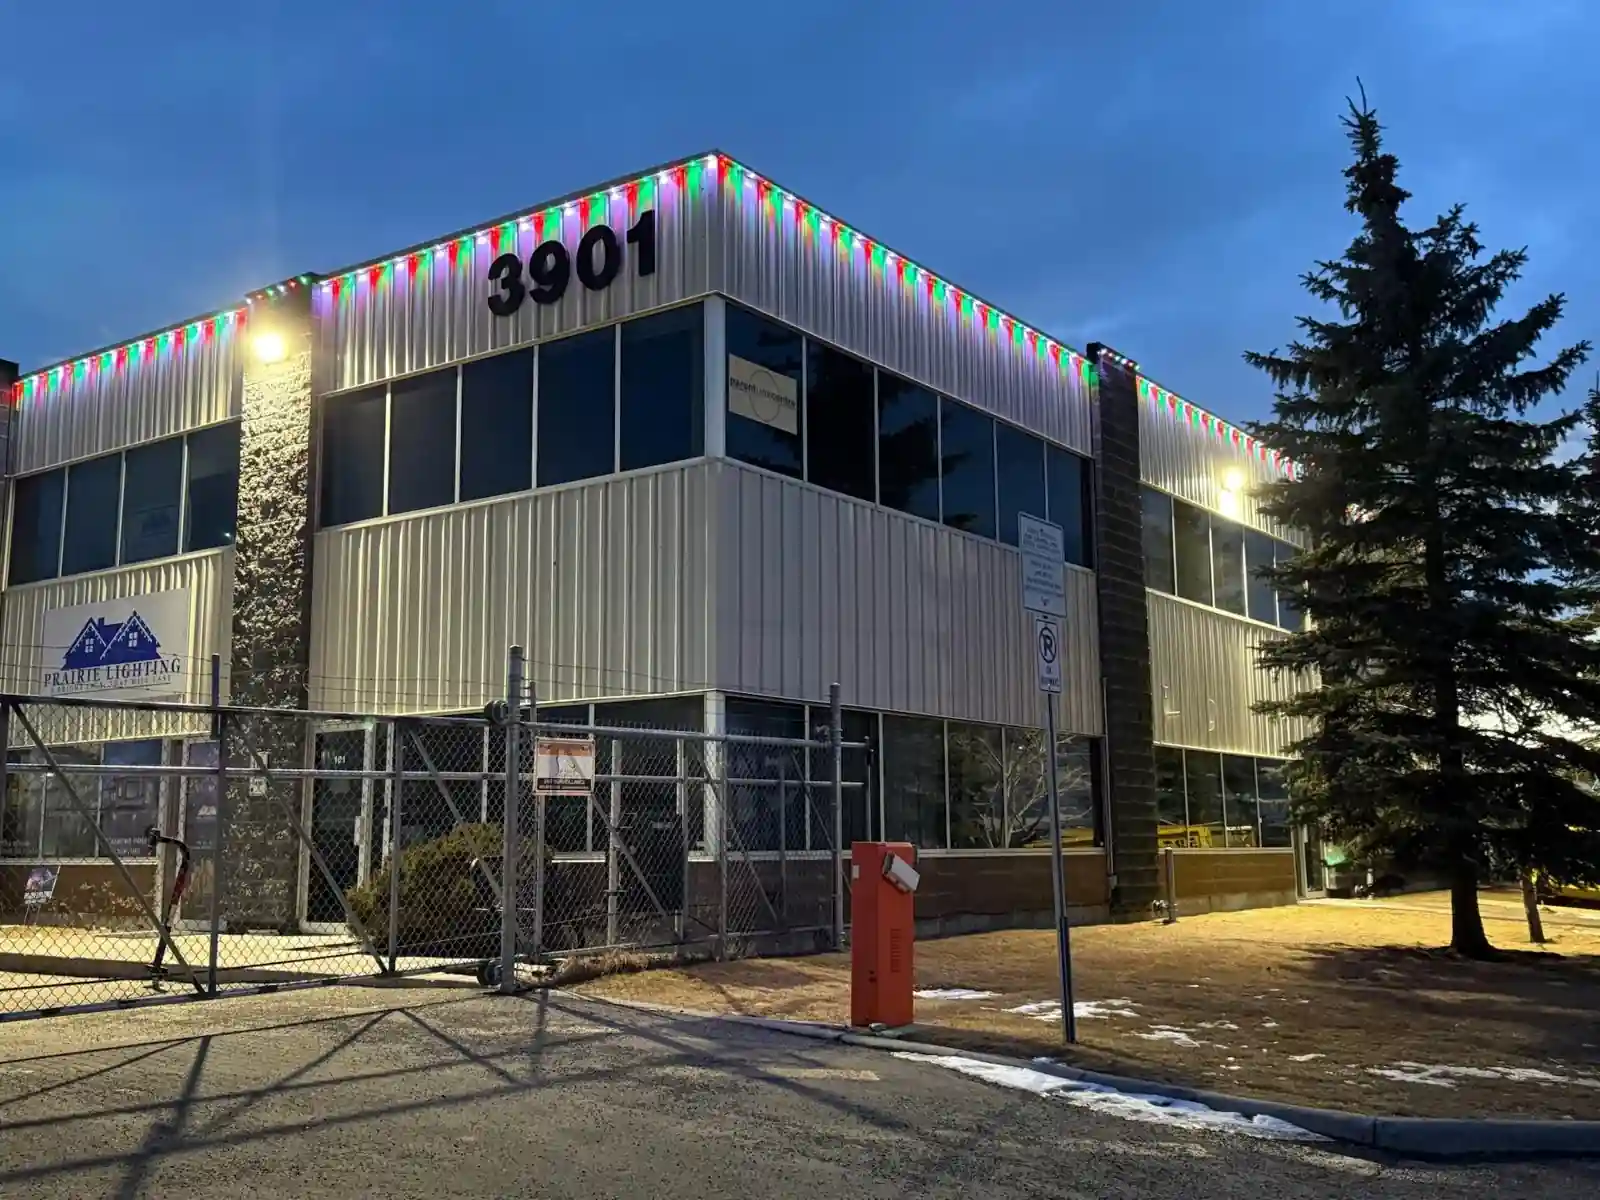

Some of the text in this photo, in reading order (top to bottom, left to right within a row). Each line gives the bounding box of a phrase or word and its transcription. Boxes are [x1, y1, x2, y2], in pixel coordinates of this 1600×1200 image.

[488, 209, 655, 316] 3901
[44, 668, 101, 687] PRAIRIE
[106, 658, 181, 681] LIGHTING
